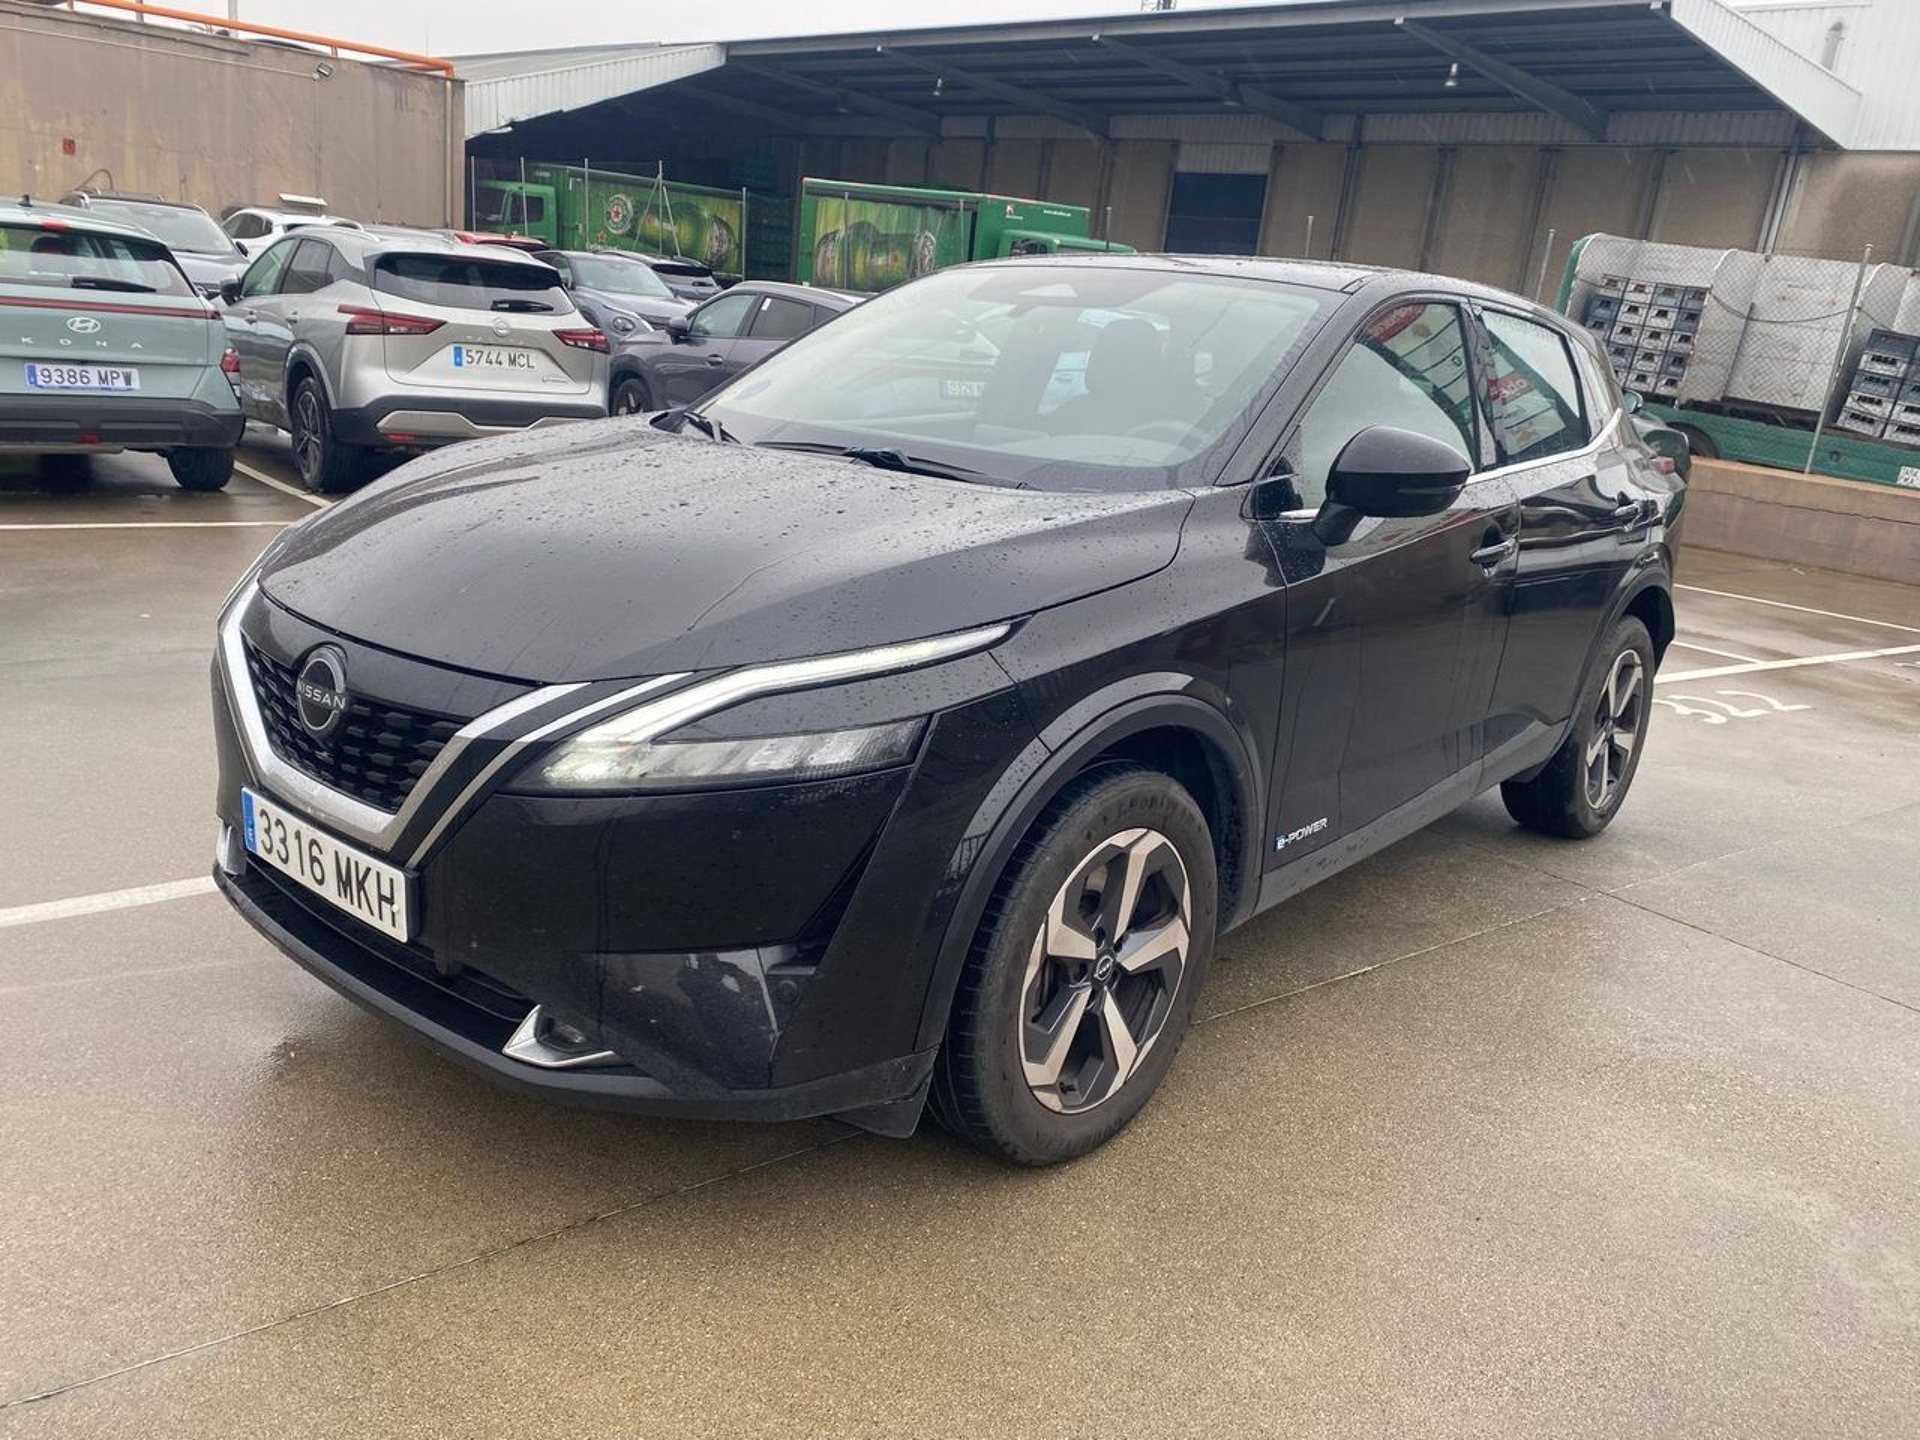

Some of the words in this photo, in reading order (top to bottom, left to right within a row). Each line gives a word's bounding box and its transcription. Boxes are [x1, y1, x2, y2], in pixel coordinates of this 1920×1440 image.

[21, 336, 143, 349] KONA
[466, 349, 503, 366] 5744
[508, 352, 535, 369] MCL
[40, 368, 91, 385] 9386
[97, 369, 133, 387] MPW
[258, 808, 326, 887] 3316
[334, 849, 397, 929] MKH
